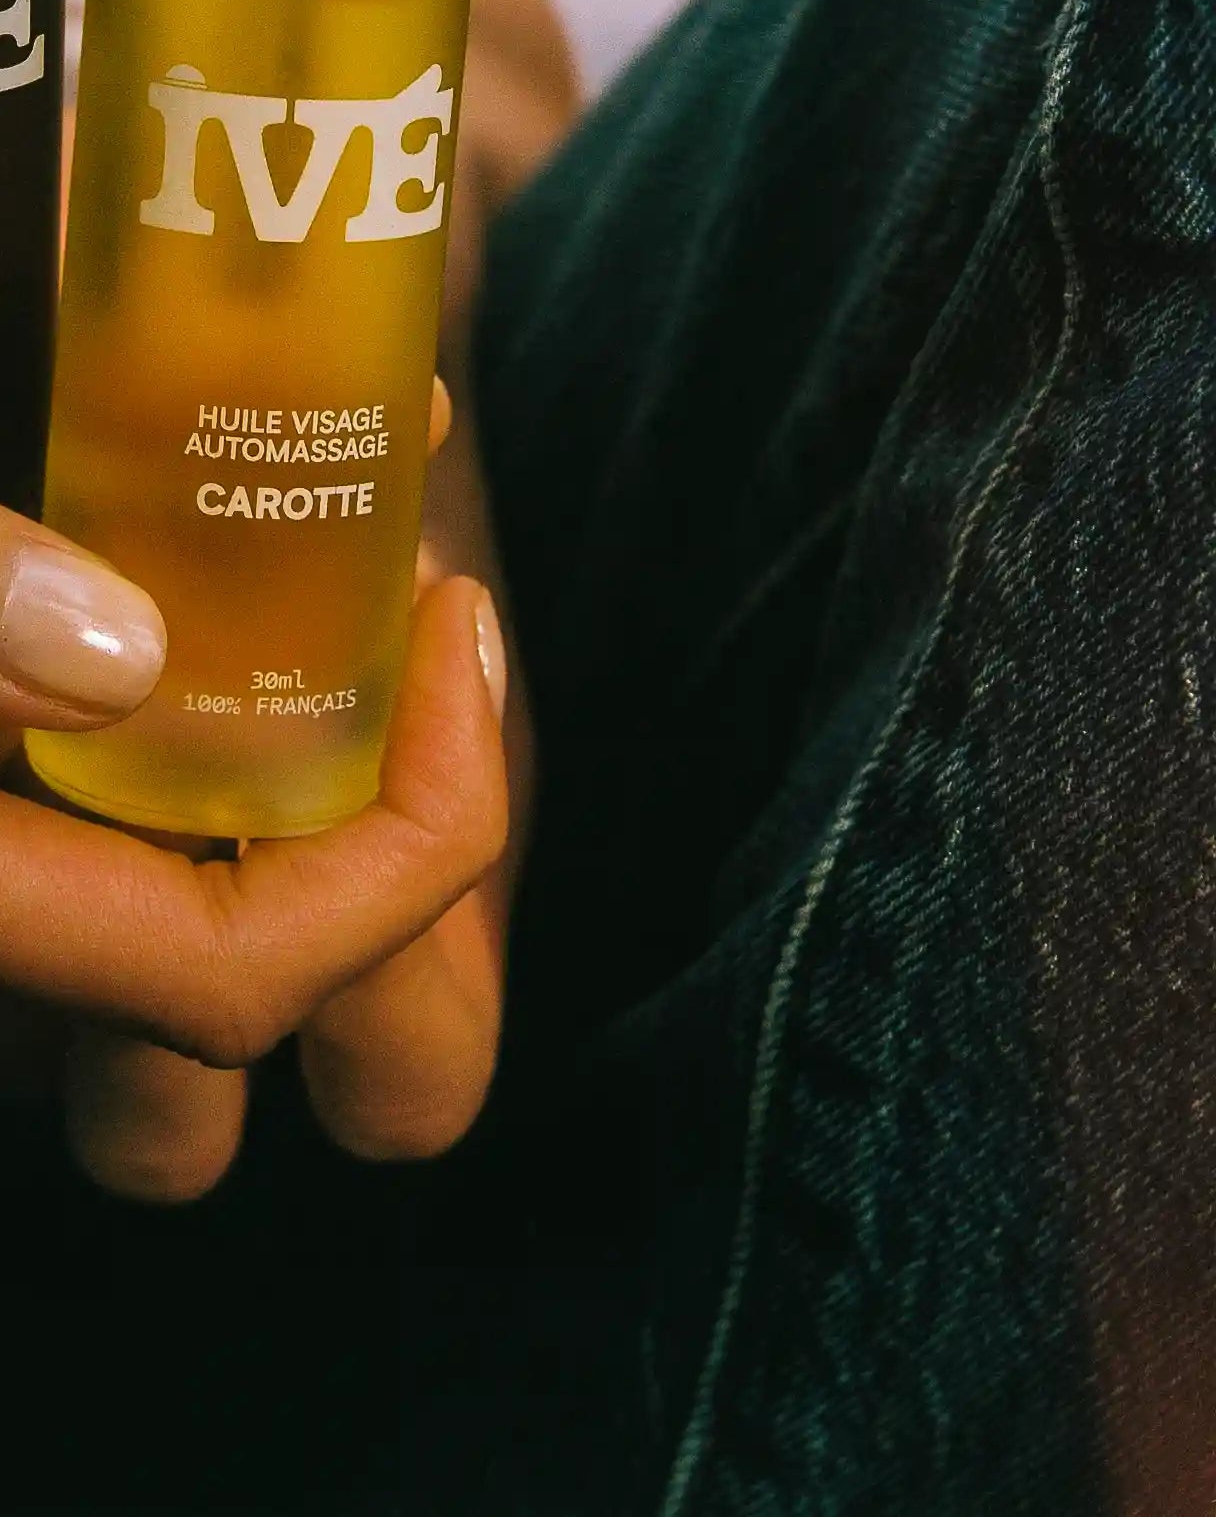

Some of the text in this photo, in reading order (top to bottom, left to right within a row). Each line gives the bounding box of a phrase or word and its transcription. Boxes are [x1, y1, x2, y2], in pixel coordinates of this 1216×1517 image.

[198, 404, 385, 435] HUILE VISAGE
[184, 432, 389, 463] AUTOMASSAGE
[196, 482, 375, 521] CAROTTE
[250, 669, 305, 690] 30ml
[181, 689, 357, 719] 100% FRANÇAIS
